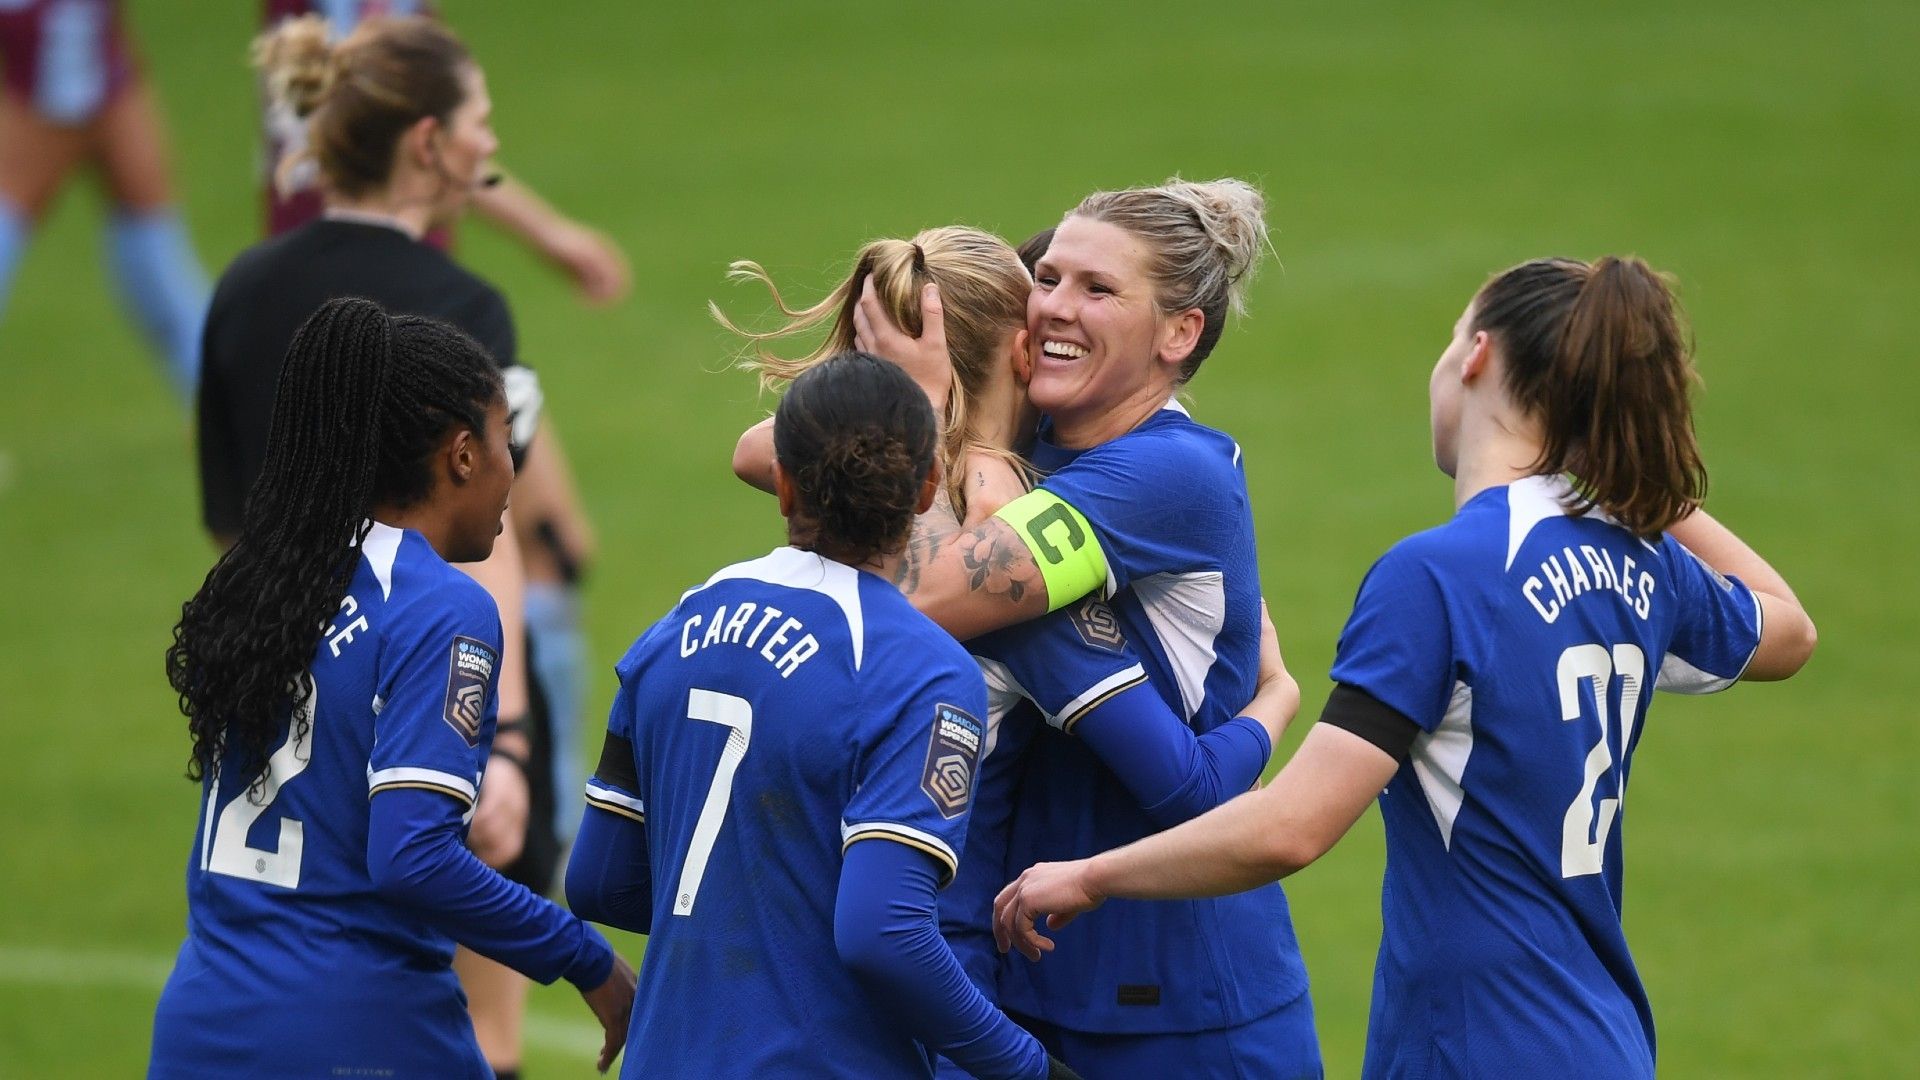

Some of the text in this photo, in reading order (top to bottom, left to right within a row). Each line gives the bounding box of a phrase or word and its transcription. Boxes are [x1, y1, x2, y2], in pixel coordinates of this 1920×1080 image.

[1026, 502, 1085, 564] C
[1522, 544, 1655, 623] CHARLES
[319, 595, 369, 658] CE
[680, 602, 820, 679] CARTER
[200, 672, 318, 889] 12
[1556, 643, 1645, 878] 21
[673, 688, 752, 916] 7
